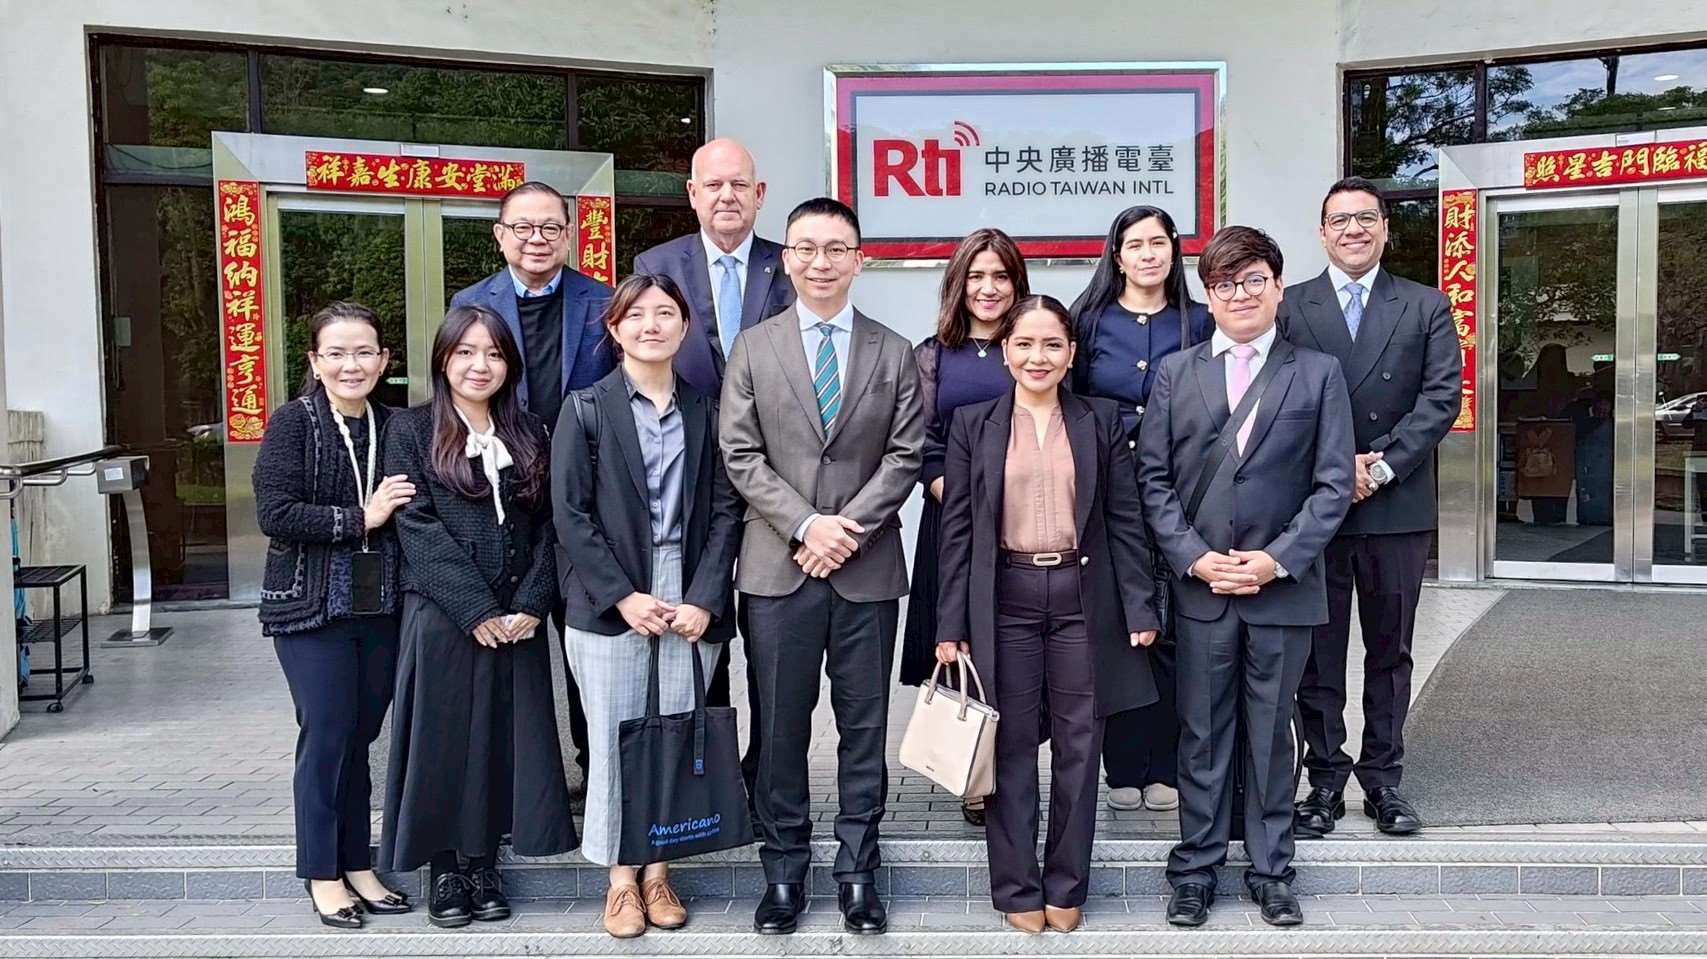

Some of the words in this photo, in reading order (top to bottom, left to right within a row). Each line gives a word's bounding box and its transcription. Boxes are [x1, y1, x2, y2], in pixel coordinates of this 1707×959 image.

[873, 133, 966, 197] Rti
[984, 145, 1175, 173] 中央廣播電臺
[984, 181, 1047, 196] RADIO
[1050, 181, 1126, 196] TAIWAN
[1132, 180, 1175, 195] INTL
[580, 209, 610, 282] 豐財
[223, 194, 263, 415] 鴻福納祥運亨通
[647, 813, 721, 837] Americano
